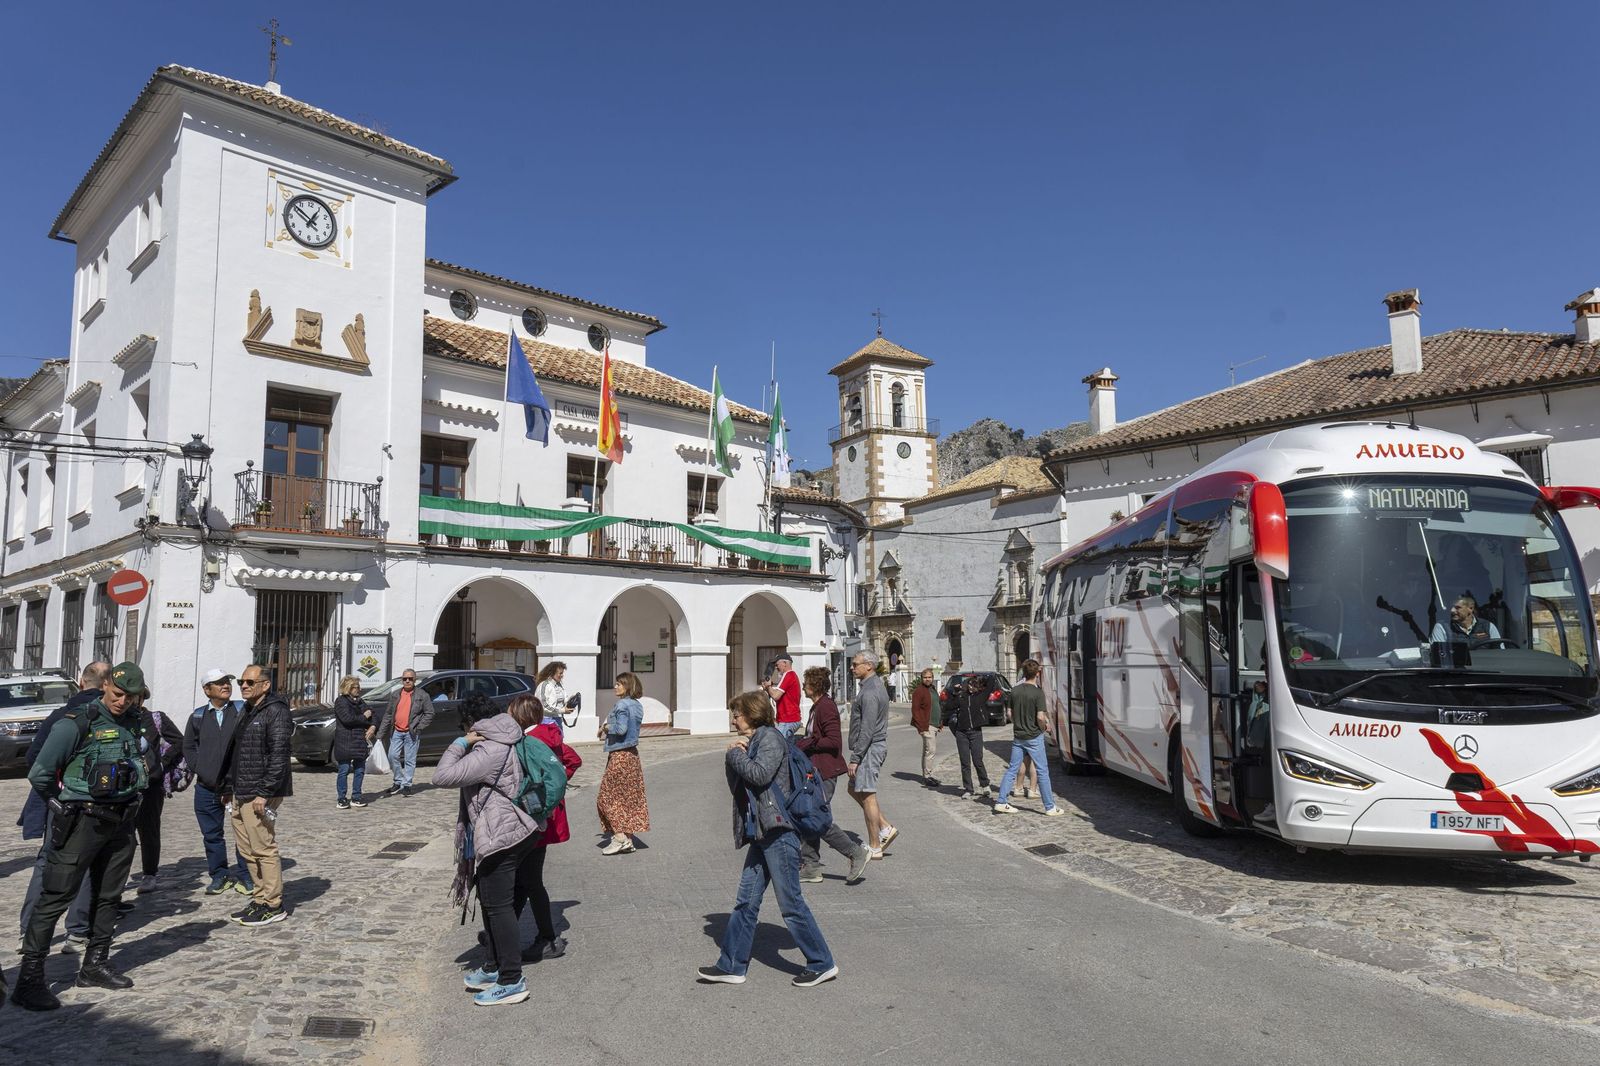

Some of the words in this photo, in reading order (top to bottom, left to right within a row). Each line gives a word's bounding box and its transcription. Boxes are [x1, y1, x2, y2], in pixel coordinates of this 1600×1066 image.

[1356, 443, 1465, 460] AMUEDO
[1368, 488, 1469, 510] NATURANDA
[1329, 722, 1402, 738] AMUEDO
[1442, 815, 1473, 829] 1957
[1476, 817, 1501, 829] NFT
